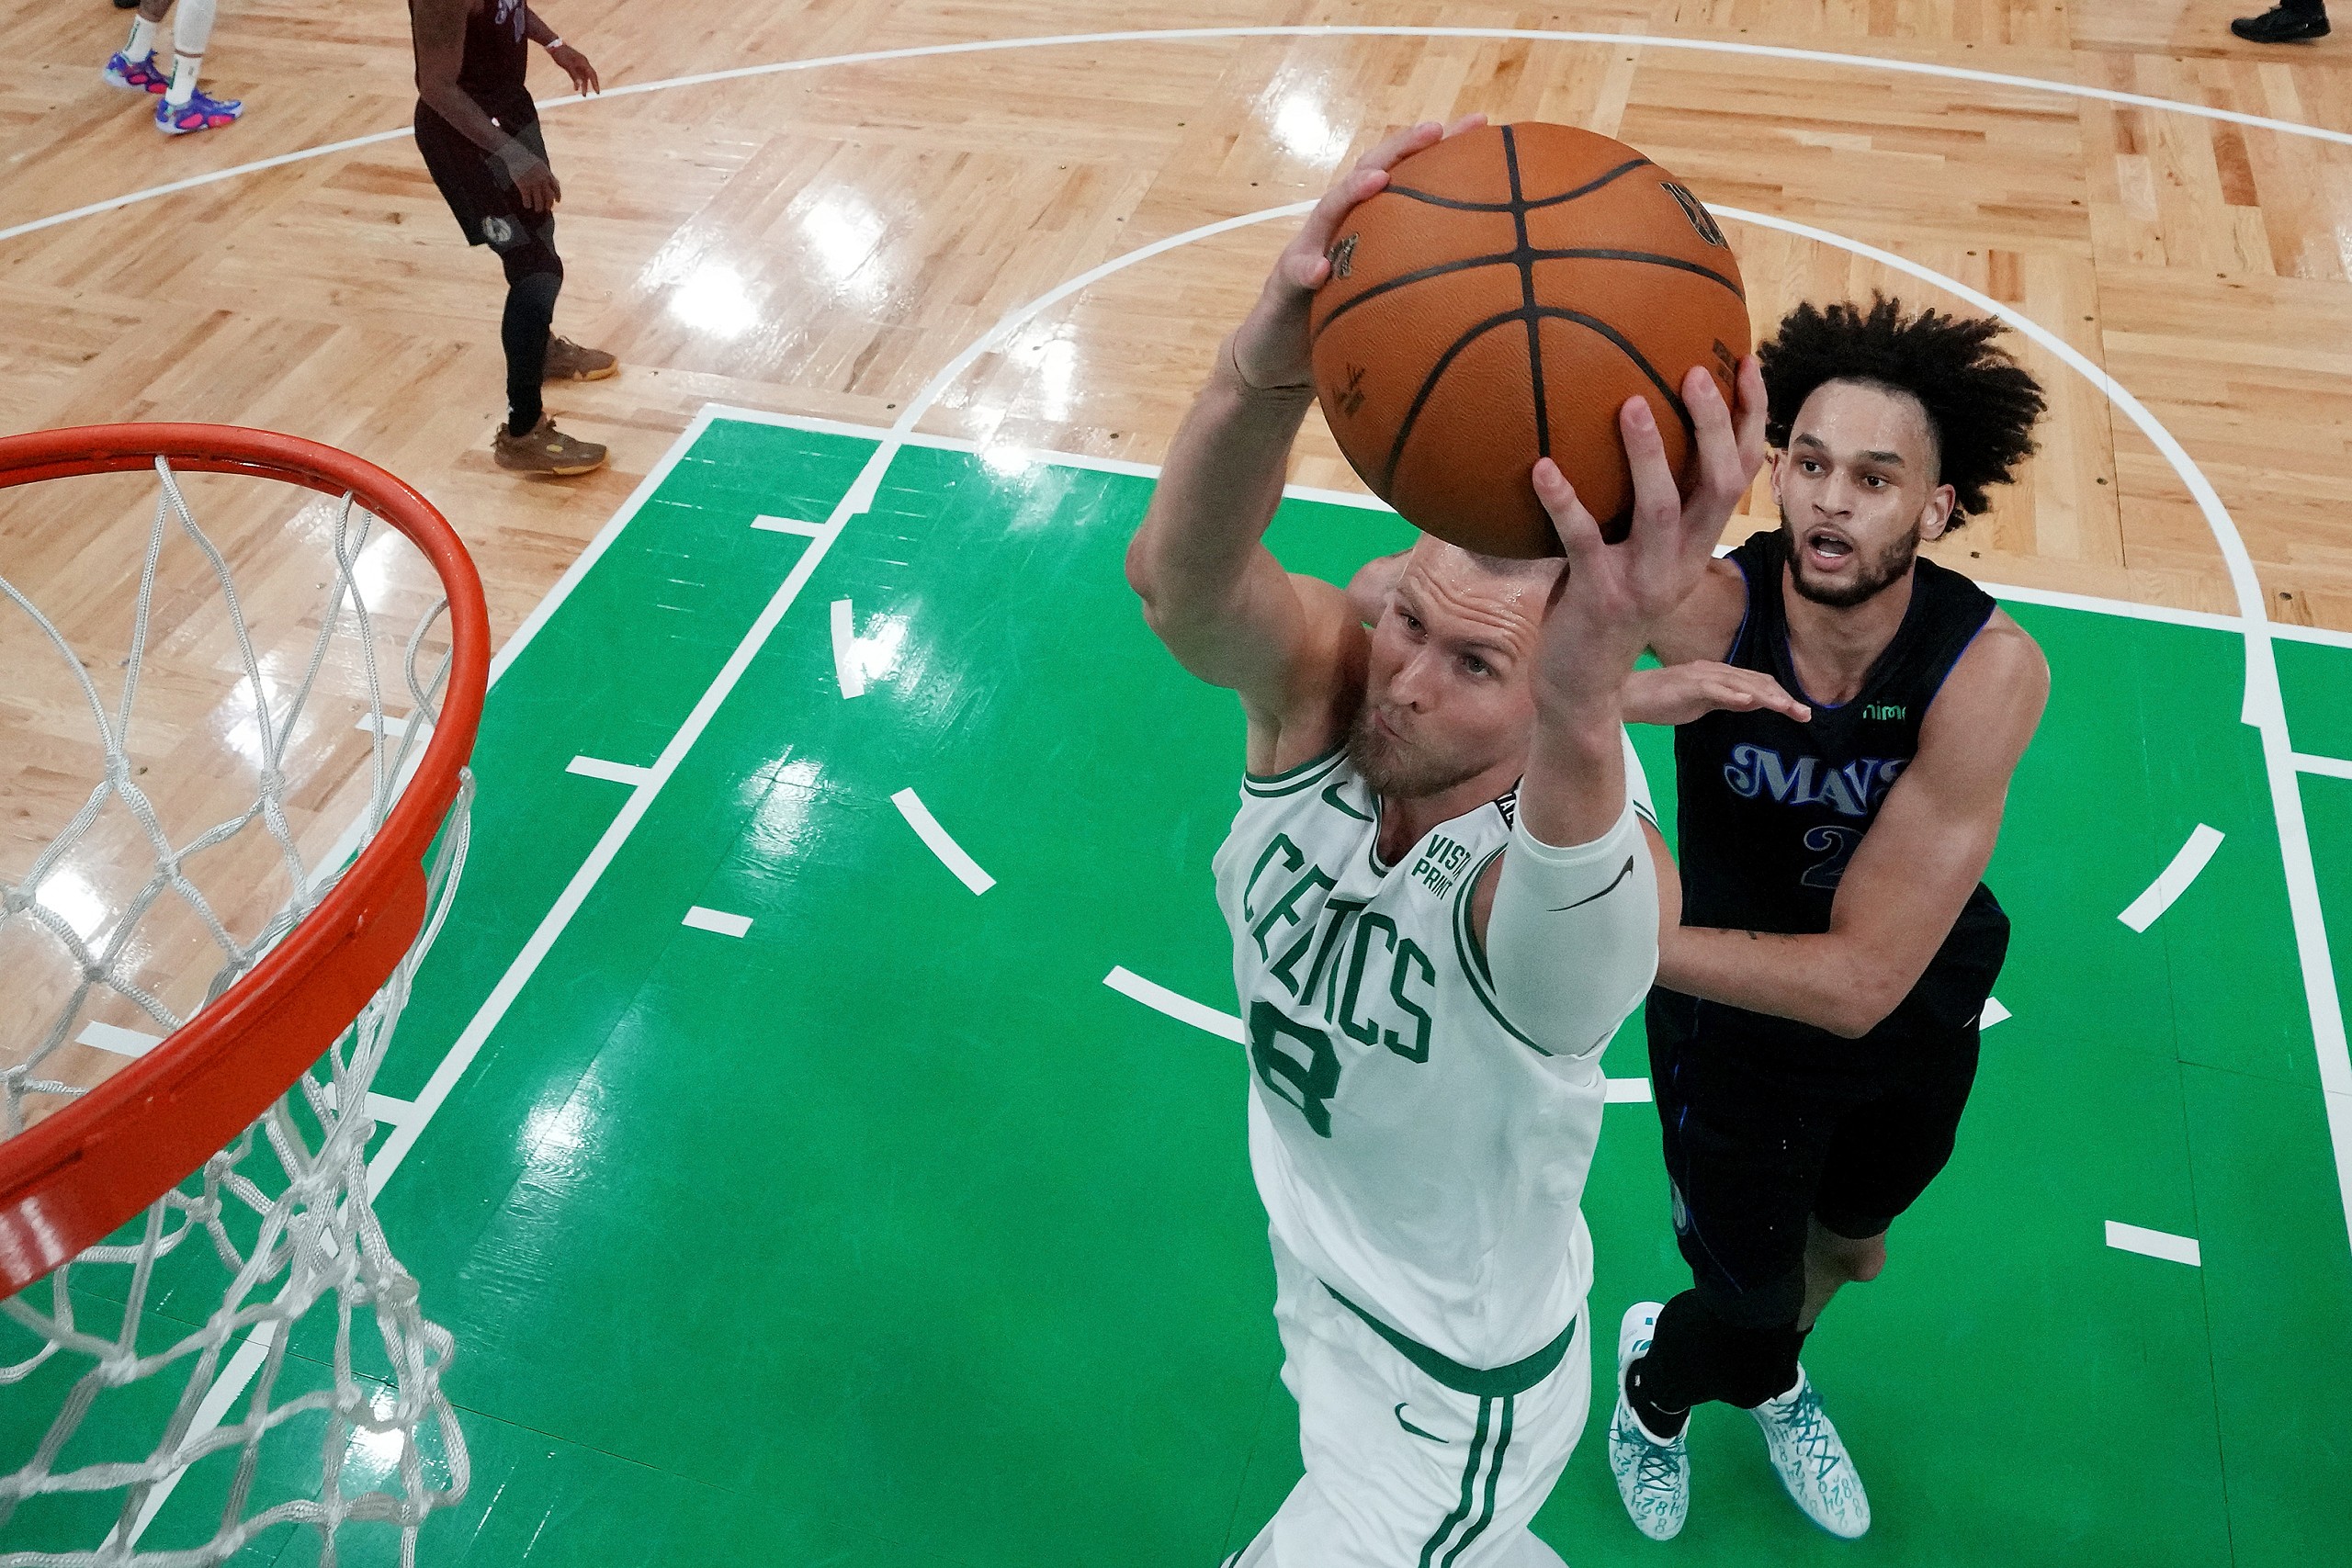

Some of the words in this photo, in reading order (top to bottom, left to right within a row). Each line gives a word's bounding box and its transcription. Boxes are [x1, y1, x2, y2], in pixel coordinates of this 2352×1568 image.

[1411, 857, 1453, 900] PRINT
[1425, 834, 1472, 881] VISTA
[1800, 825, 1866, 889] 2
